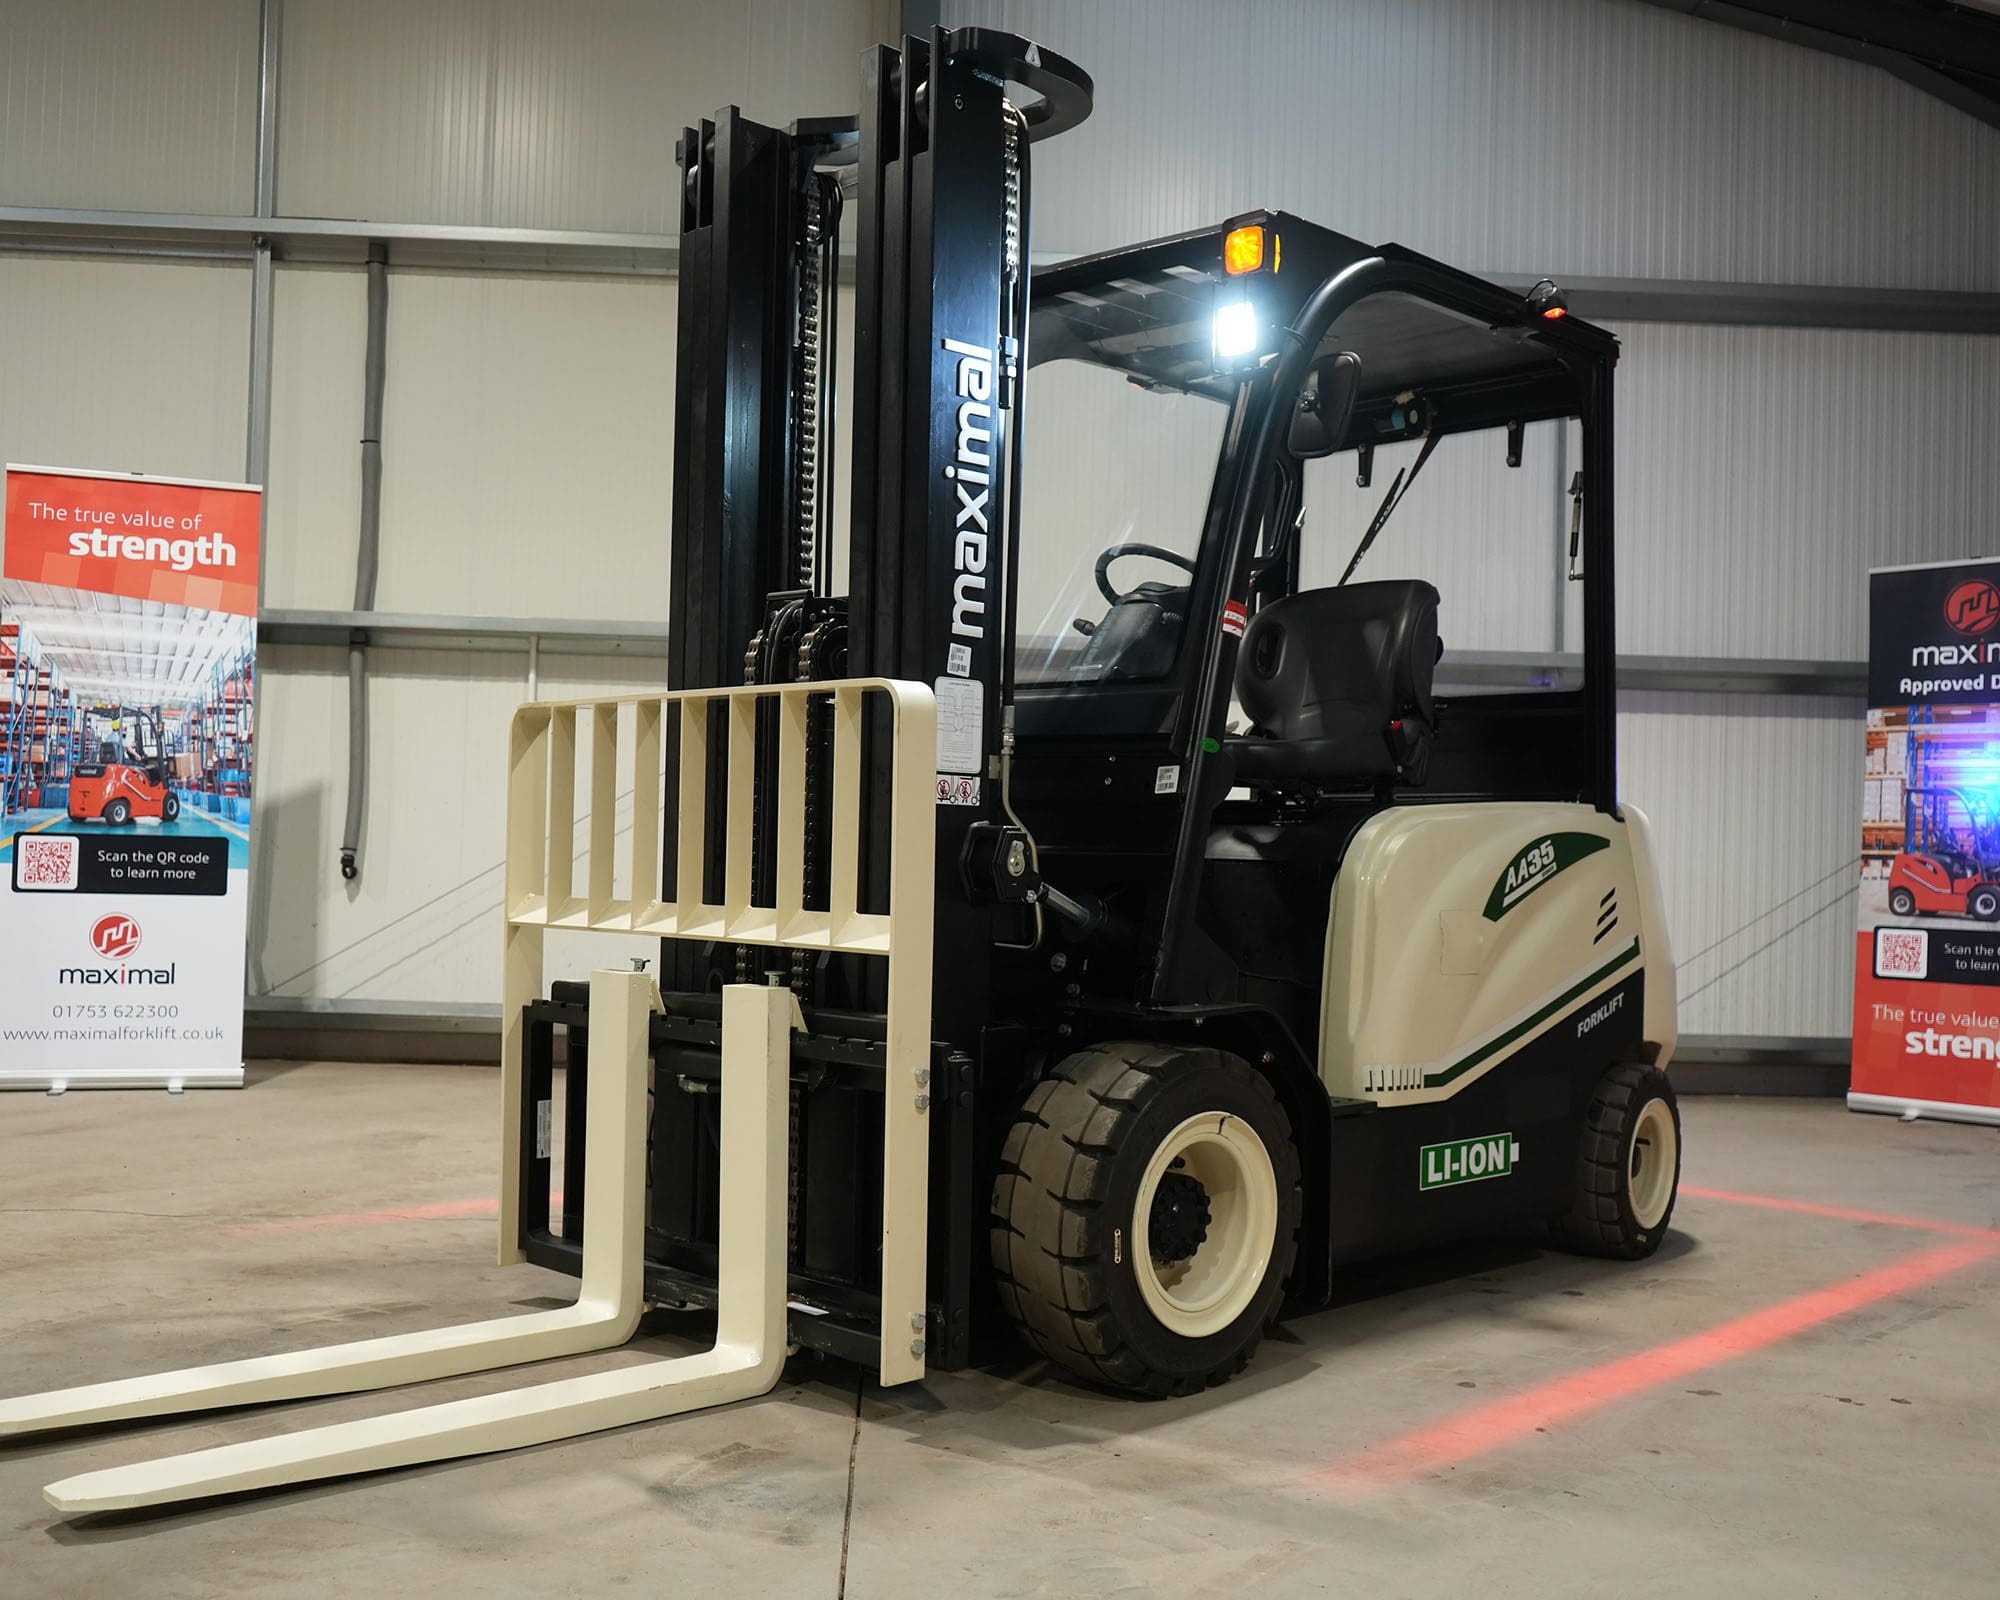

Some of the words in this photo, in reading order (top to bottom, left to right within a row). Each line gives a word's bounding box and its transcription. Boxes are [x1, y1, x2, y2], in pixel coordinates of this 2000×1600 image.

[942, 338, 993, 639] maximal
[28, 502, 68, 521] The
[74, 506, 116, 525] true
[121, 510, 175, 530] value
[181, 514, 203, 531] of
[69, 528, 236, 571] strength
[1900, 673, 1984, 697] Approved
[97, 850, 128, 863] Scan
[132, 850, 153, 863] the
[157, 851, 176, 866] QR
[180, 851, 210, 865] code
[1504, 839, 1555, 894] AA35
[110, 866, 123, 879] to
[127, 866, 160, 879] learn
[163, 868, 196, 880] more
[1944, 942, 1971, 956] Scan
[1975, 944, 1994, 957] the
[59, 962, 175, 985] maximal
[1955, 959, 1967, 970] to
[1970, 959, 2000, 972] learn
[52, 1004, 107, 1019] 01753
[113, 1005, 179, 1019] 622300
[1576, 992, 1625, 1038] FORKLIFT
[1872, 1004, 1904, 1022] The
[1910, 1007, 1946, 1025] true
[1951, 1010, 1999, 1030] value
[3, 1026, 224, 1042] www.maximalforklift.co.uk
[1905, 1027, 2000, 1069] stren
[1428, 1139, 1505, 1184] LI-ION
